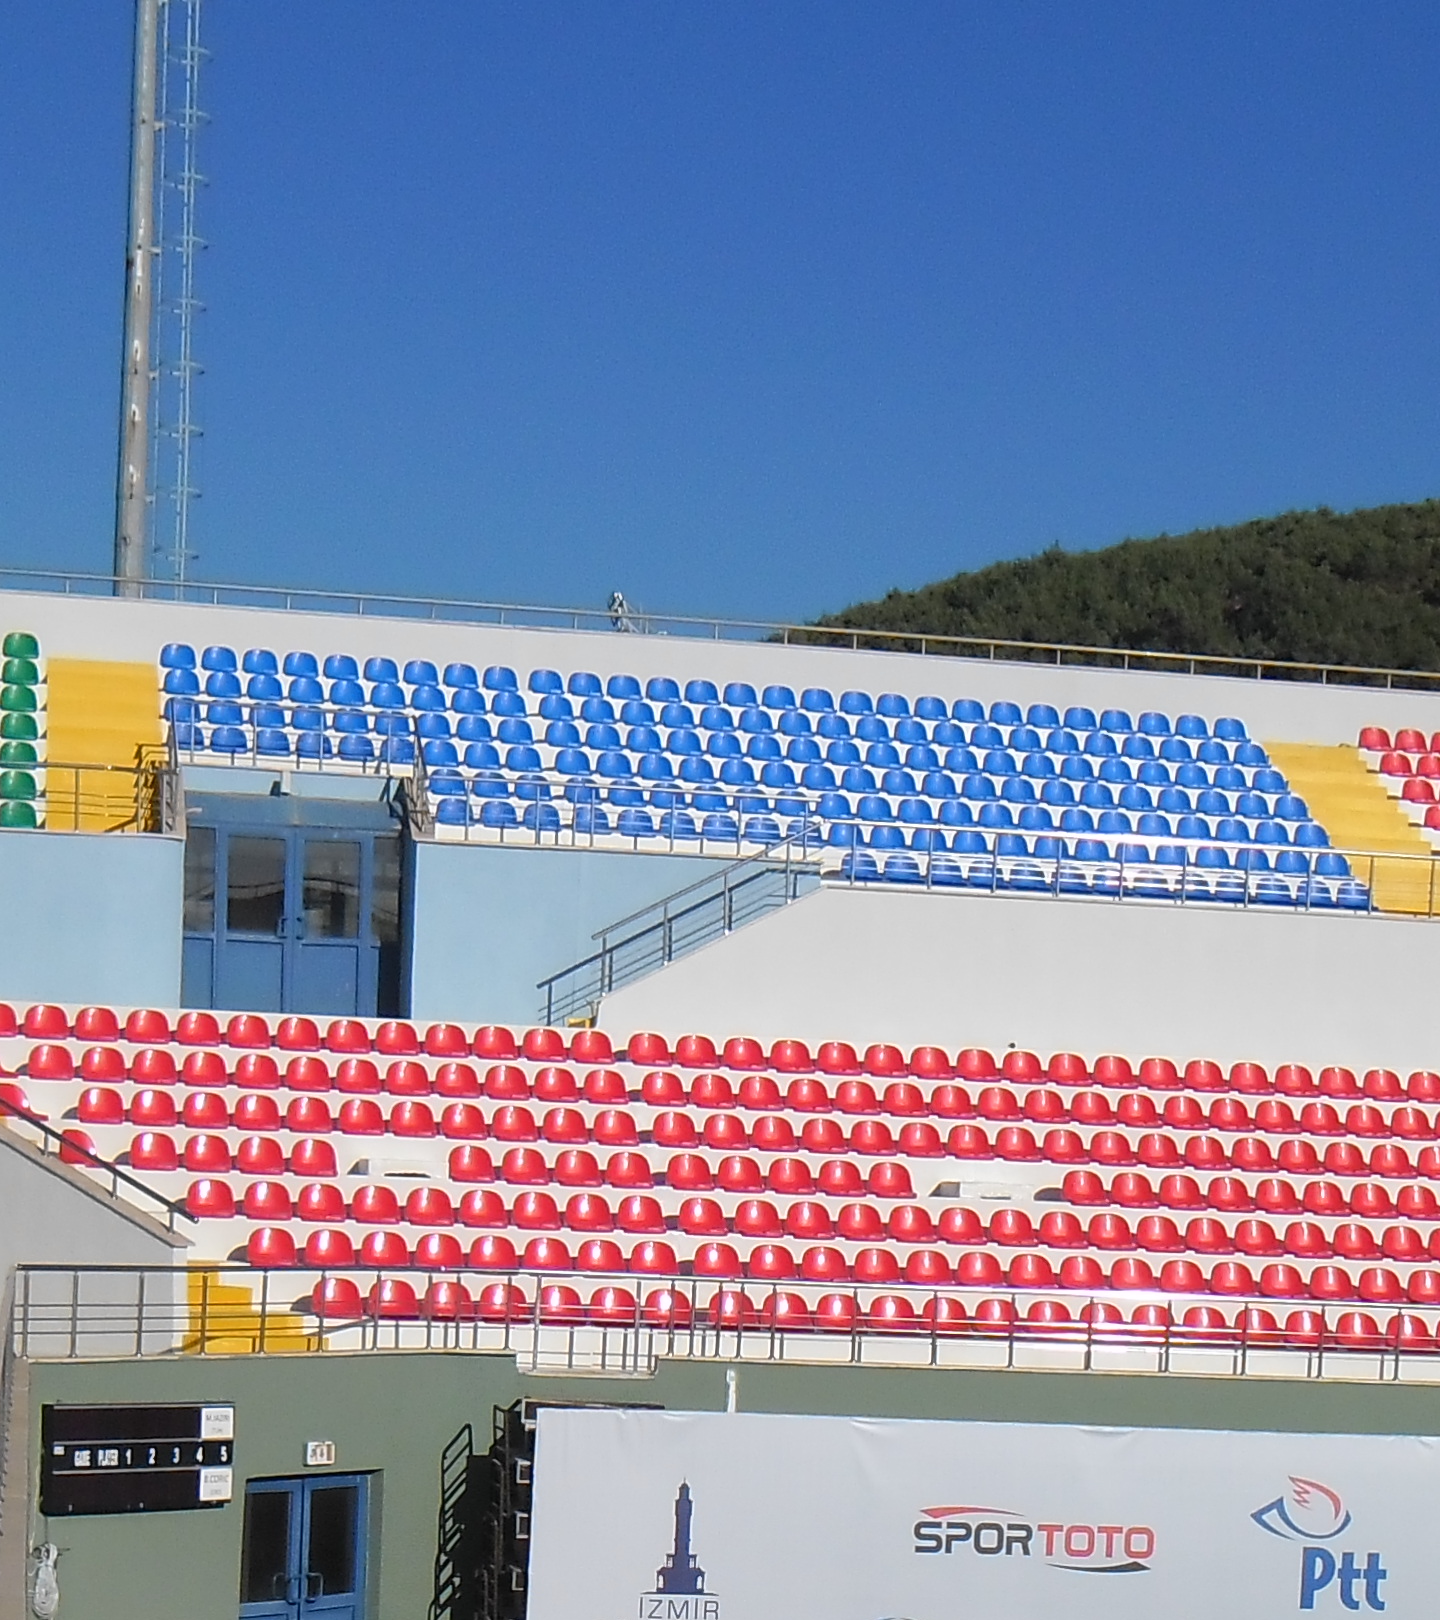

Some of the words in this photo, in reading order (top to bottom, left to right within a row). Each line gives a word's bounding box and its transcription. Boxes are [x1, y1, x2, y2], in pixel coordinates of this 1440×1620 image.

[125, 1448, 132, 1465] 1
[148, 1447, 156, 1464] 2
[172, 1447, 180, 1463] 3
[196, 1446, 204, 1462] 4
[220, 1445, 228, 1462] 5
[1299, 1546, 1387, 1611] Ptt
[639, 1596, 720, 1620] İZMİR
